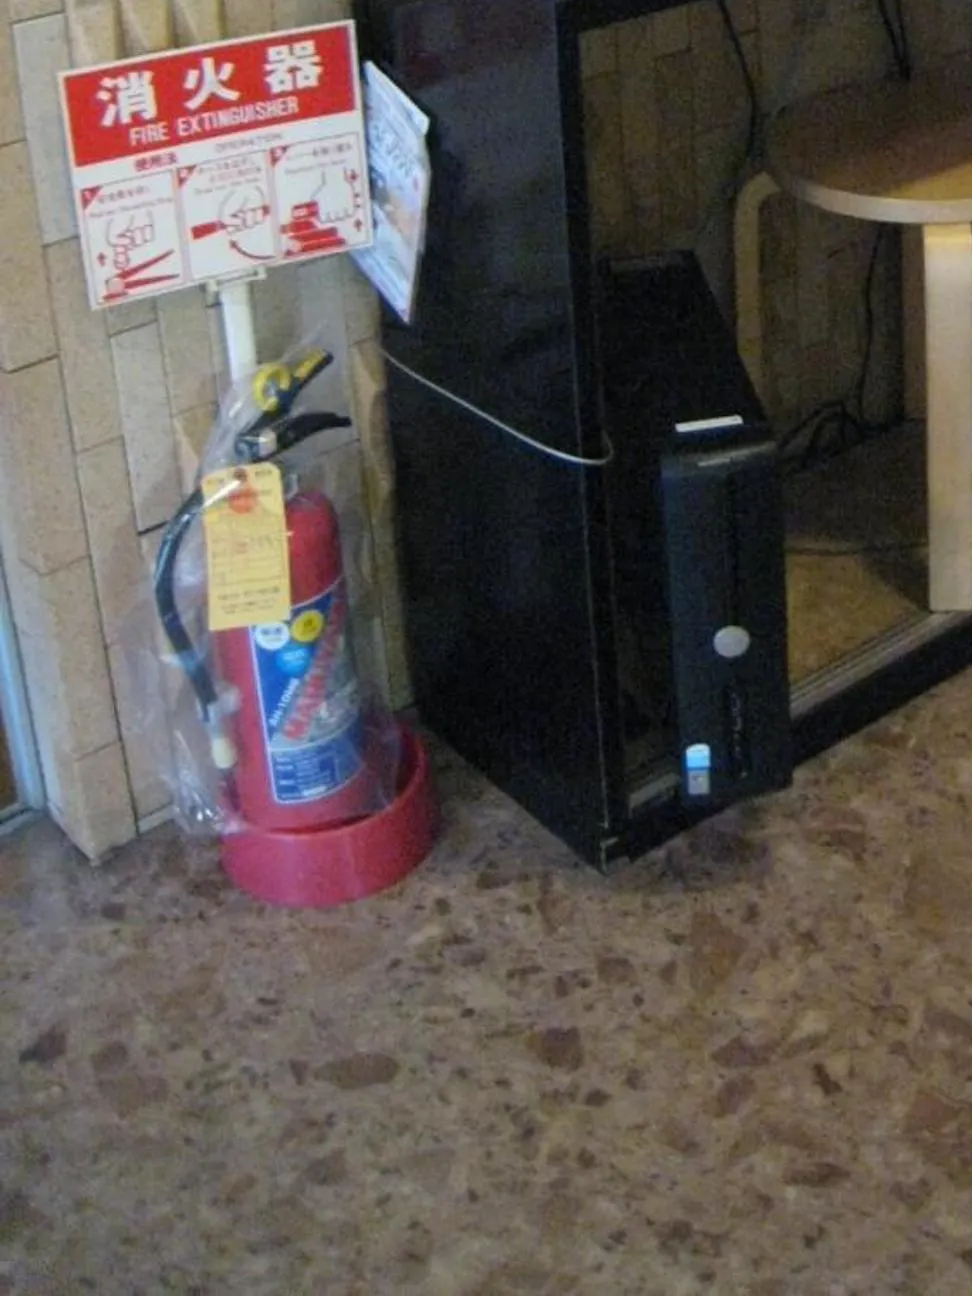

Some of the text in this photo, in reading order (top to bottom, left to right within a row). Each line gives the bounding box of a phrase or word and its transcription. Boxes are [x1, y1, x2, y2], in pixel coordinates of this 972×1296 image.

[97, 40, 323, 127] 消火器
[129, 95, 299, 147] FIRE EXTINGUISHER
